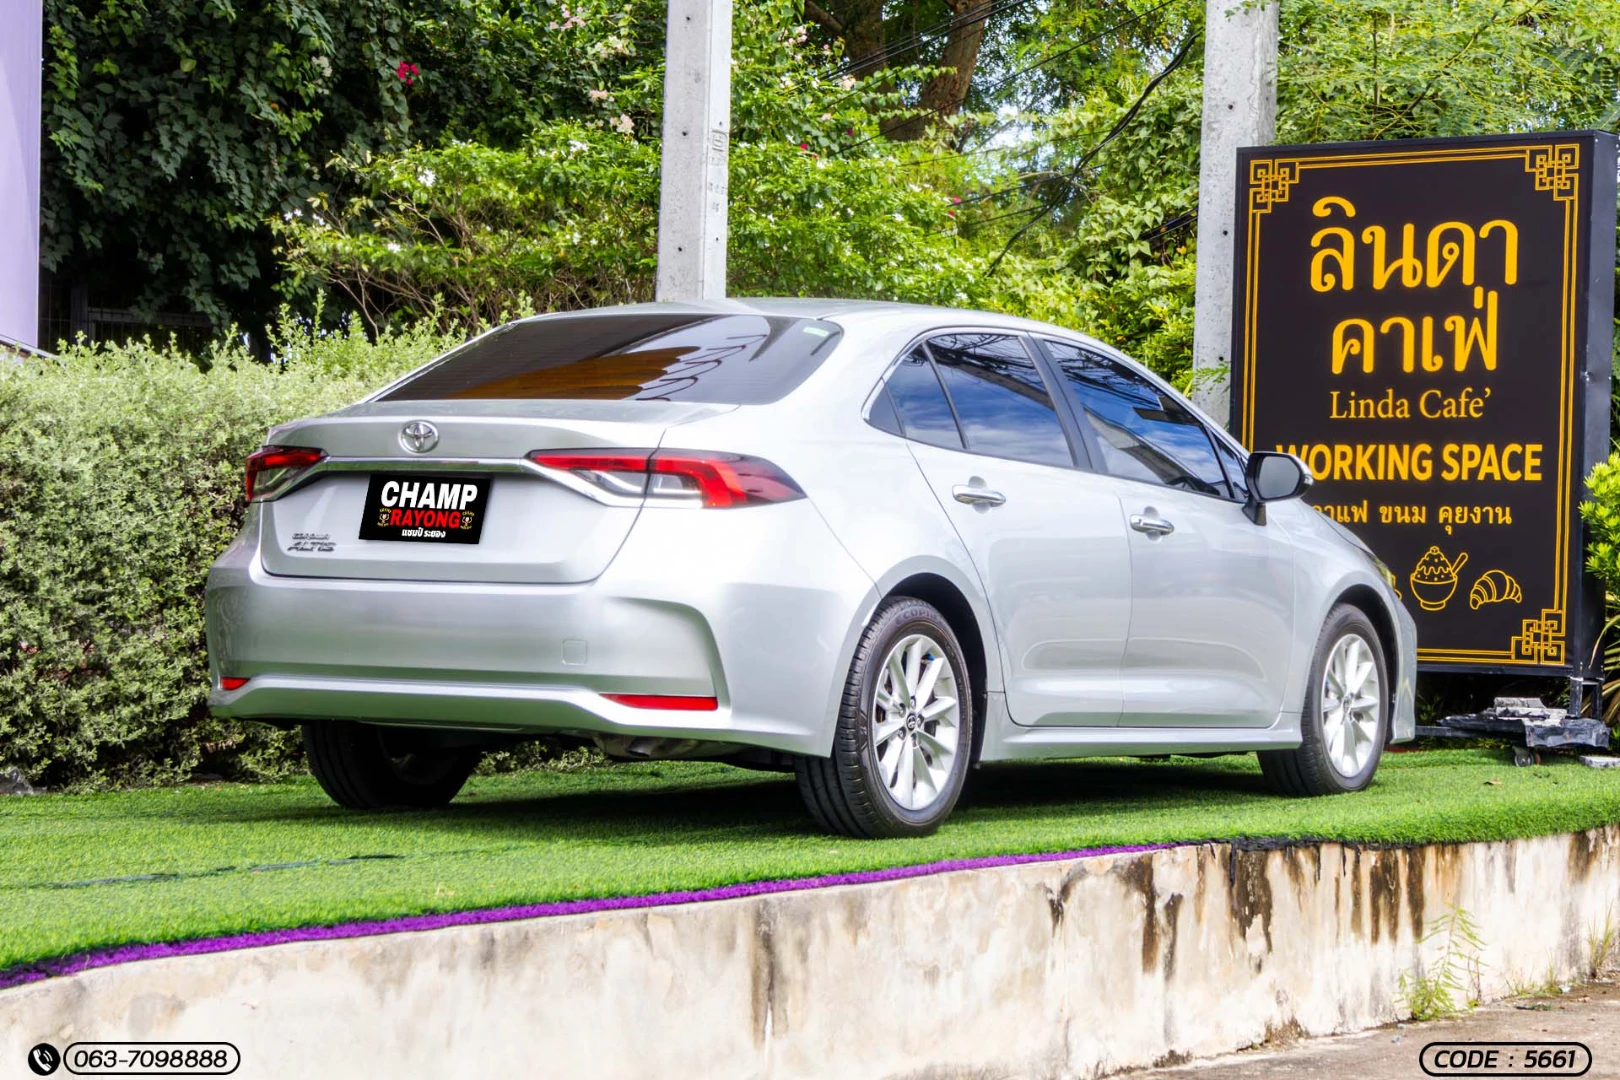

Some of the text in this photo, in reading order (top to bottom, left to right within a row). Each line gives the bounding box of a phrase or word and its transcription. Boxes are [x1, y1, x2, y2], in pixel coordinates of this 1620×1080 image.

[1311, 196, 1518, 293] ลินดา
[1331, 286, 1498, 374] คาเฟ่
[1329, 386, 1410, 419] Linda
[1441, 443, 1543, 482] SPACE
[1379, 506, 1427, 524] ขนม
[1439, 505, 1513, 535] คุยงาน
